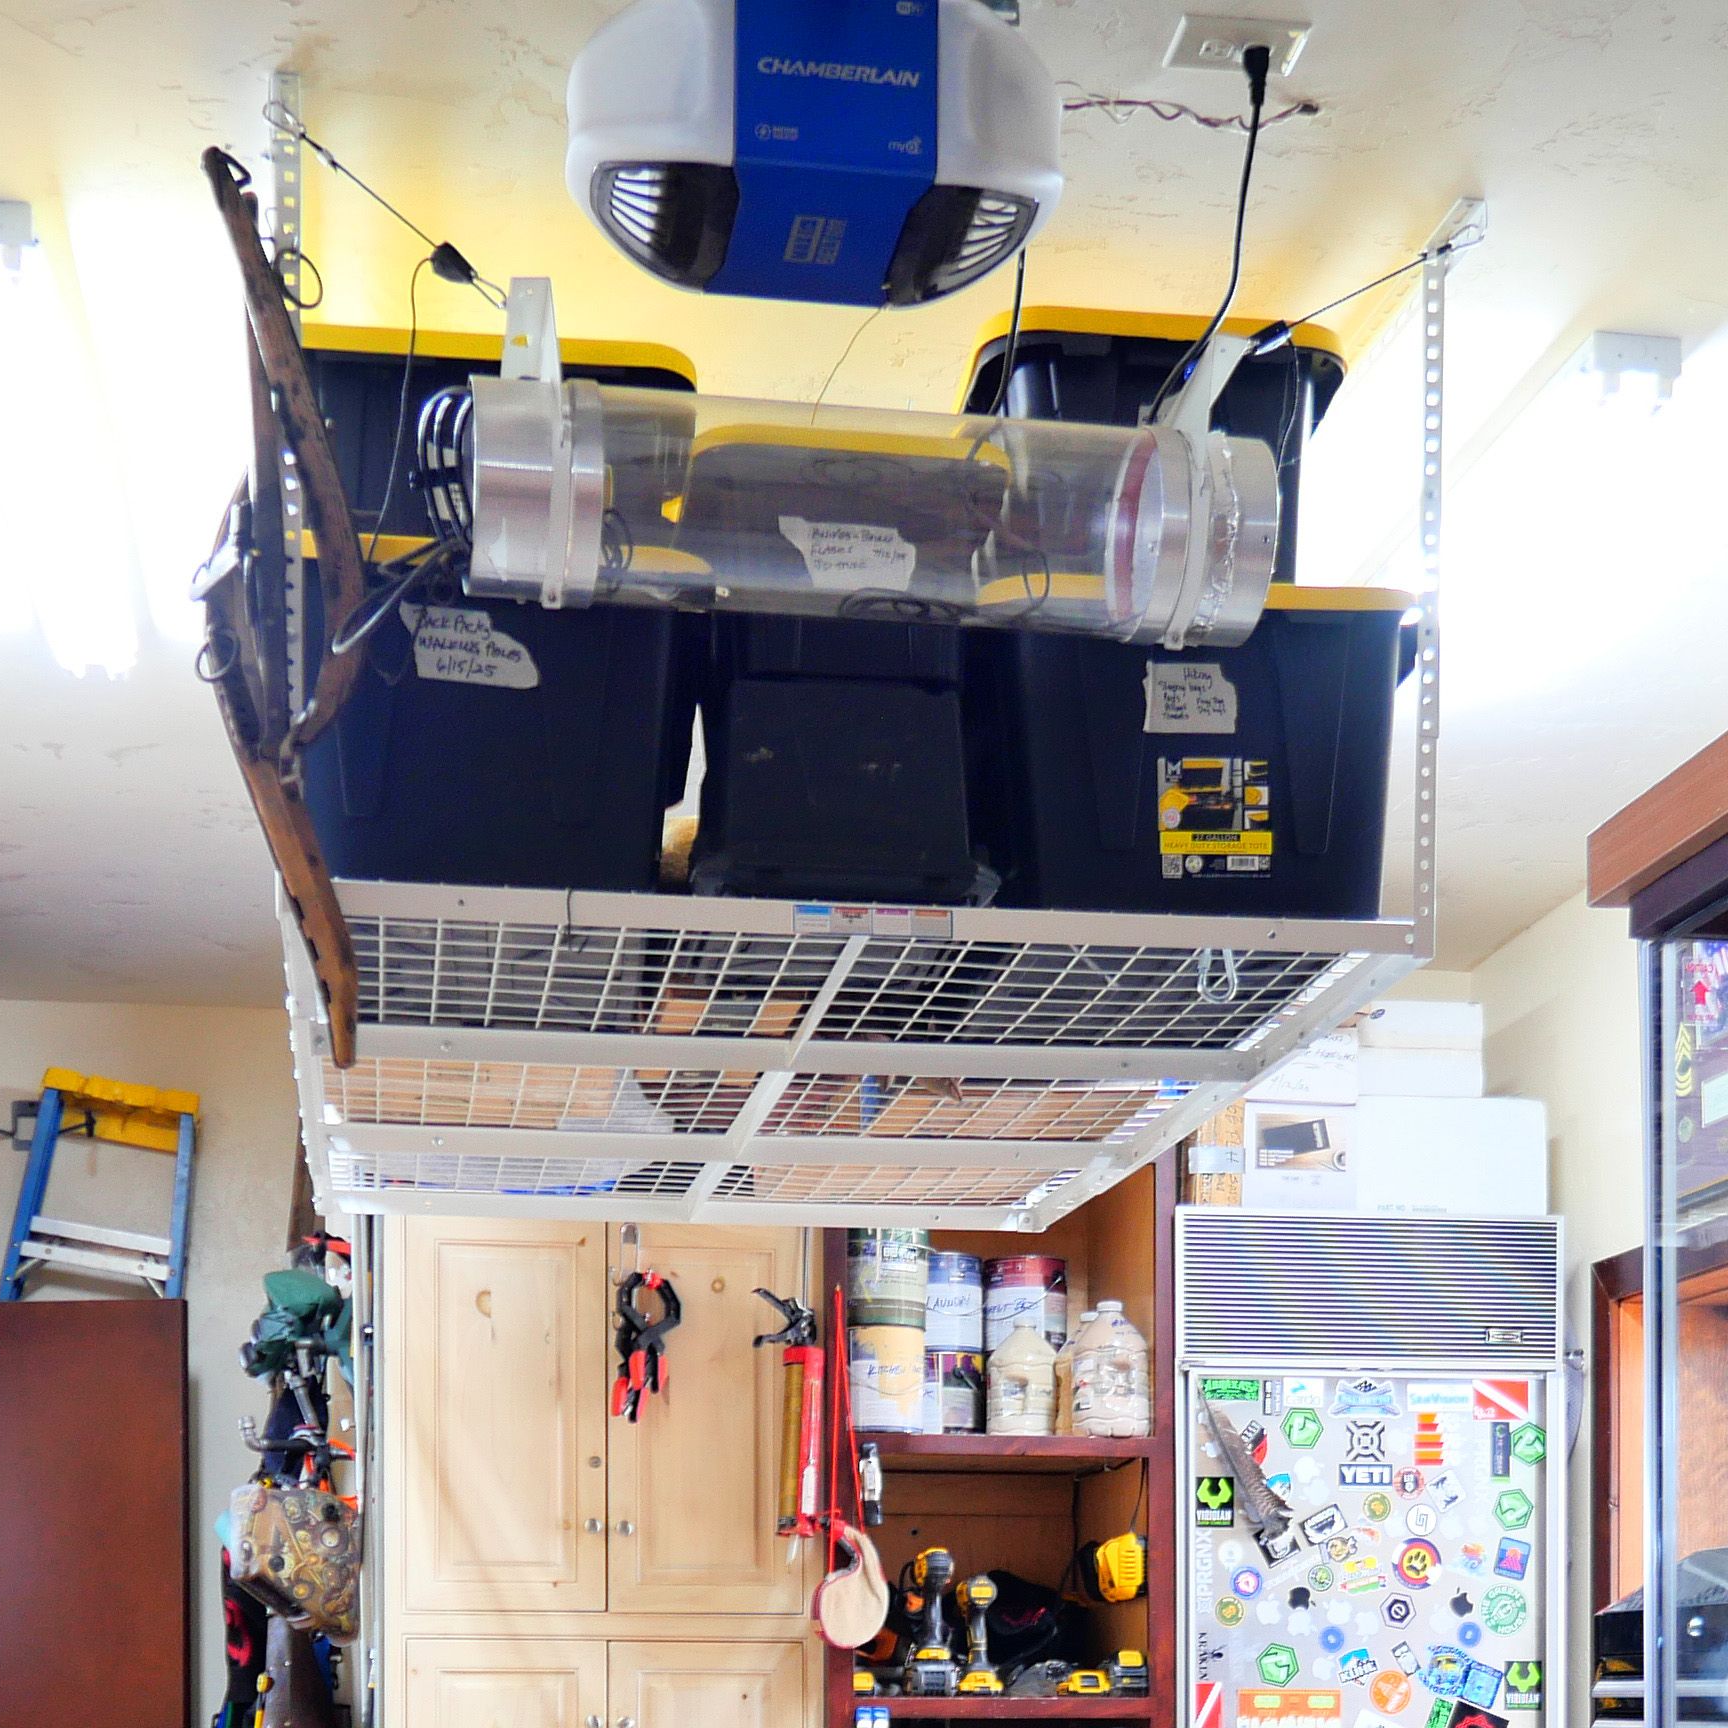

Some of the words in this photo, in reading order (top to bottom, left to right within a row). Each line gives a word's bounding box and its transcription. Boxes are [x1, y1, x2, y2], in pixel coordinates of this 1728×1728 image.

[757, 56, 920, 88] CHAMBERLAIN
[1164, 842, 1187, 850] HEAVY
[1248, 842, 1268, 850] TOTE
[1341, 1466, 1392, 1484] YETI
